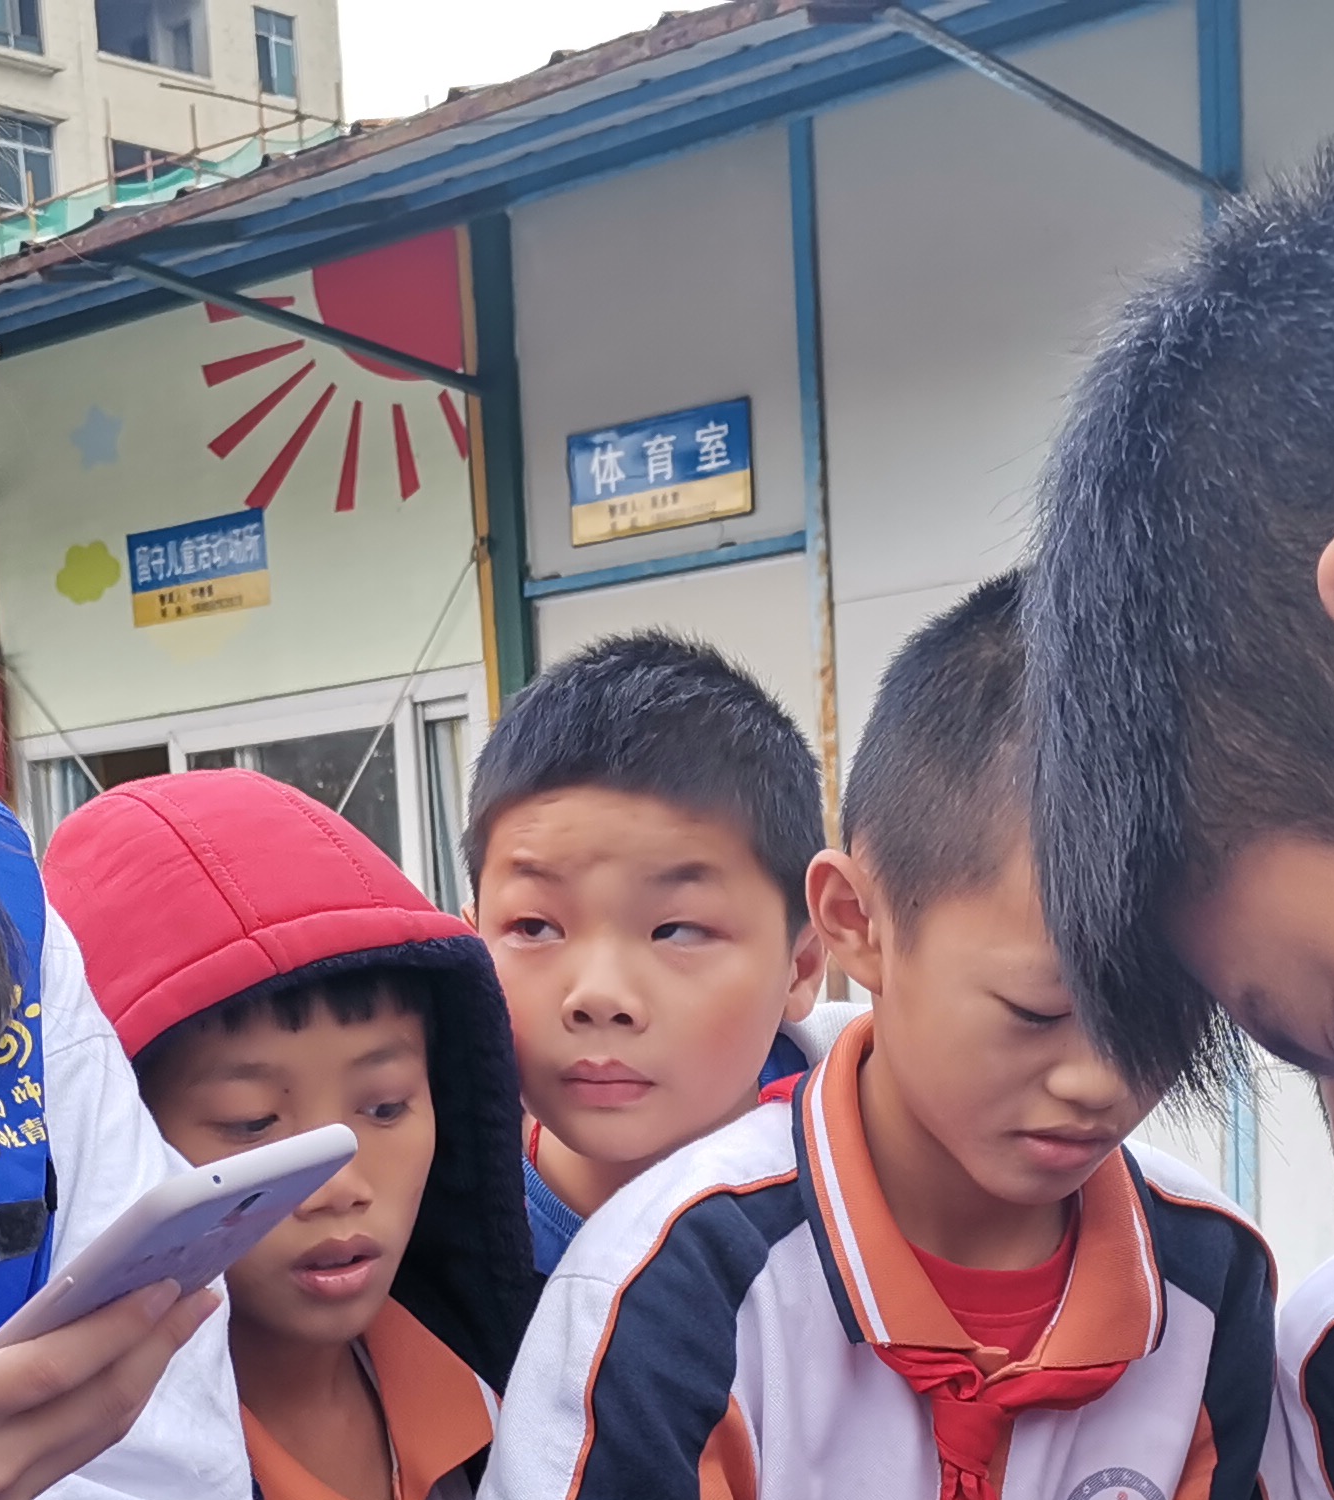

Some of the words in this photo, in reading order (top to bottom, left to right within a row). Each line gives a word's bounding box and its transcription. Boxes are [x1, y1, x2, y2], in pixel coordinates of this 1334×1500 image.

[590, 420, 731, 495] 体育室
[134, 522, 261, 585] 留守儿童活动场所
